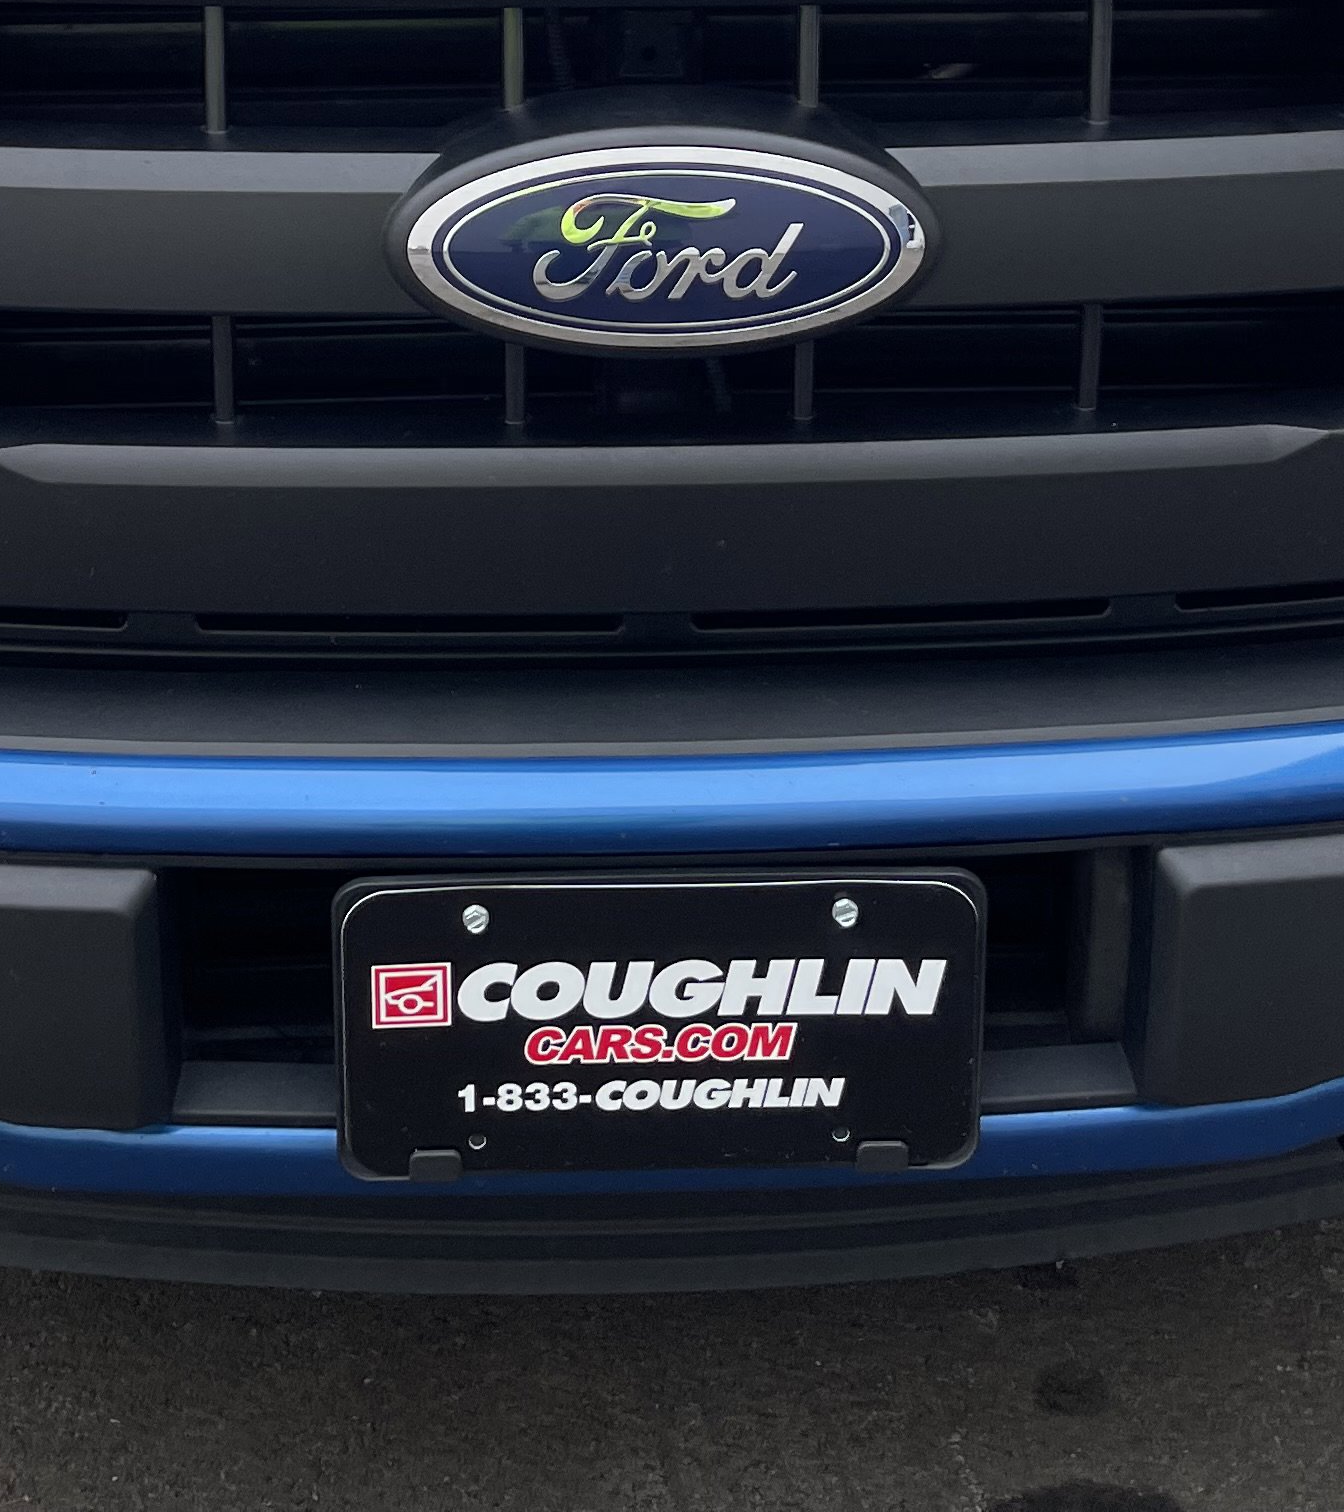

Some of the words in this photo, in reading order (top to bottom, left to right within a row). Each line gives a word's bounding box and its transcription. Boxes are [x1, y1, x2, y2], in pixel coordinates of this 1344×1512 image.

[532, 193, 805, 301] Ford
[457, 958, 947, 1021] COUGHLIN
[524, 1022, 797, 1065] CARS.COM
[457, 1077, 845, 1113] 1-833-COUGHLIN
